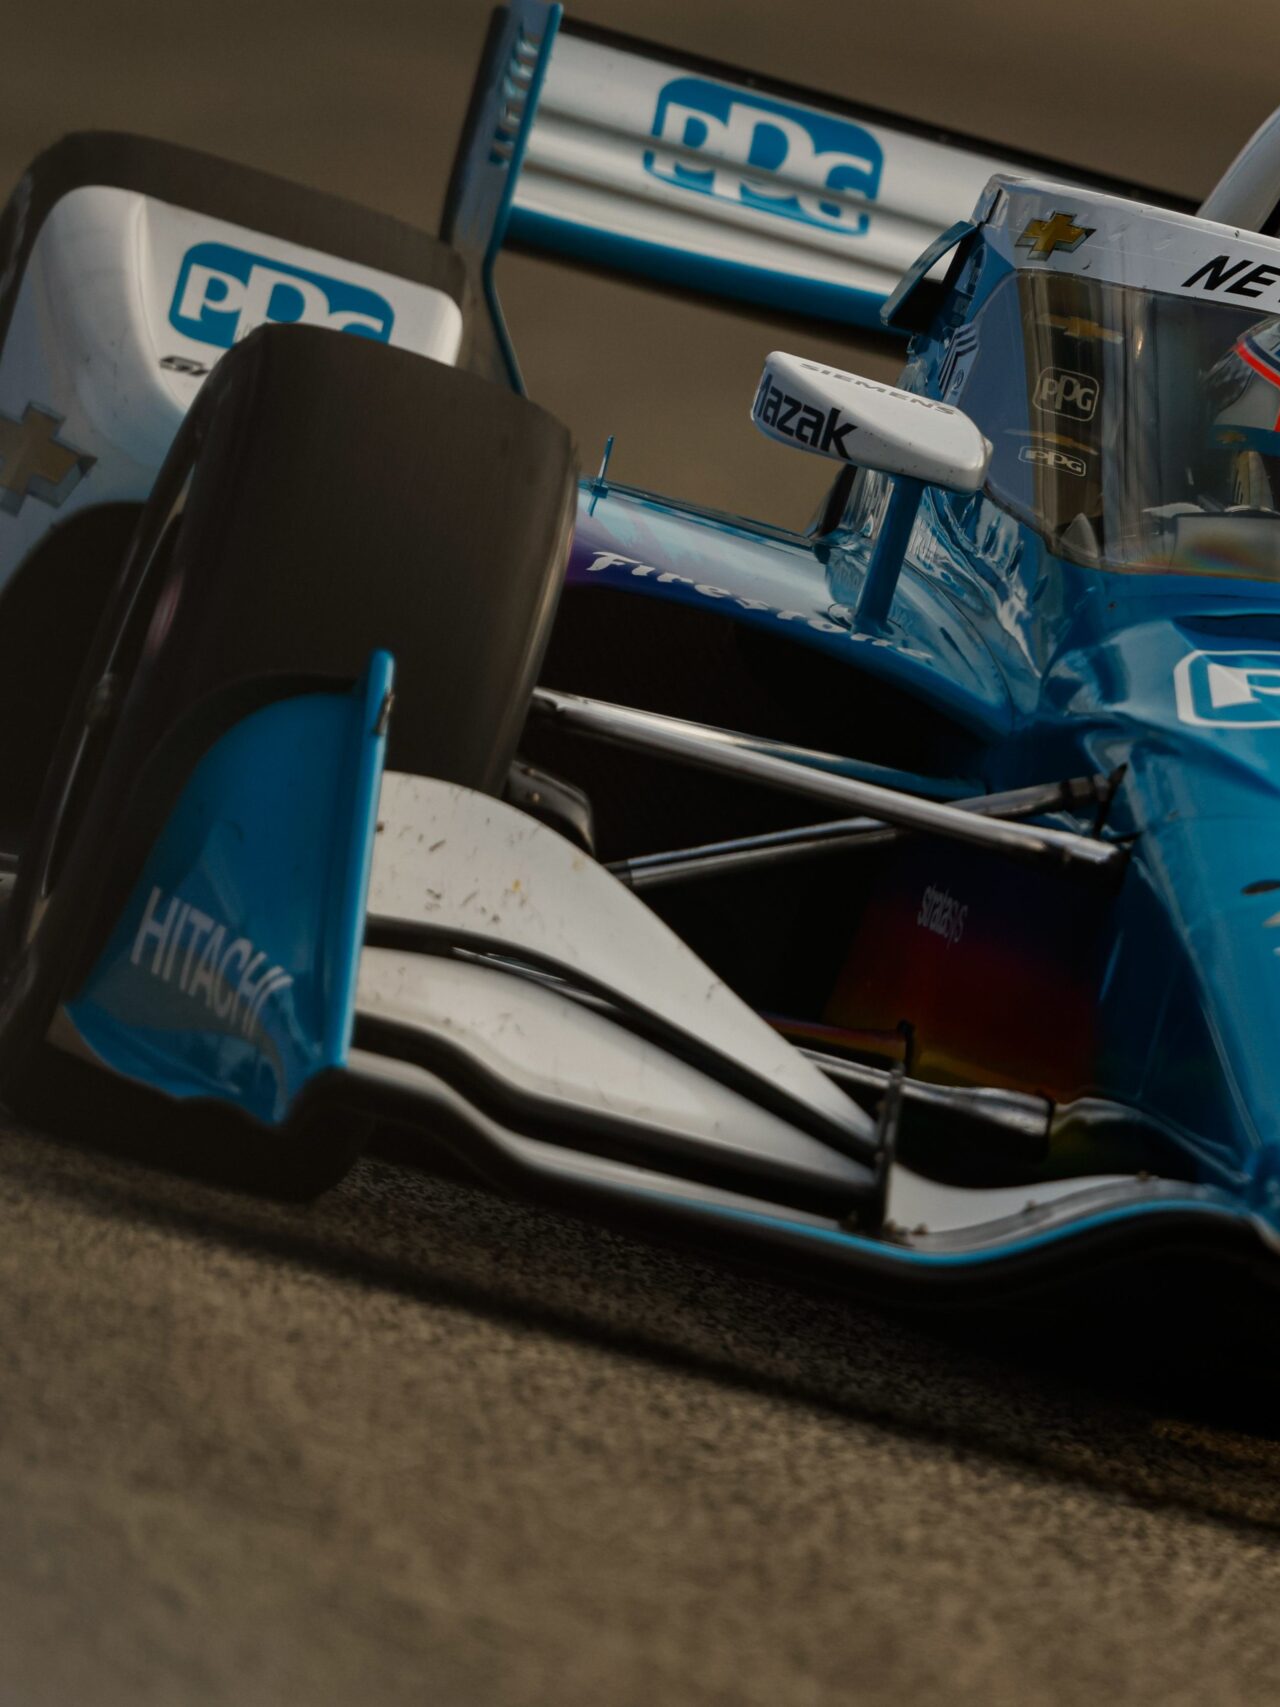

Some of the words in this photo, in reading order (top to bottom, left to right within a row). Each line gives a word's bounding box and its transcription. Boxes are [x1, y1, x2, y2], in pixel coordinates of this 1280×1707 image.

[653, 101, 873, 231] PPG
[800, 363, 954, 416] SIEMENS
[1041, 375, 1095, 411] PPG
[1025, 450, 1082, 472] PPG
[130, 885, 294, 1039] HITACHI
